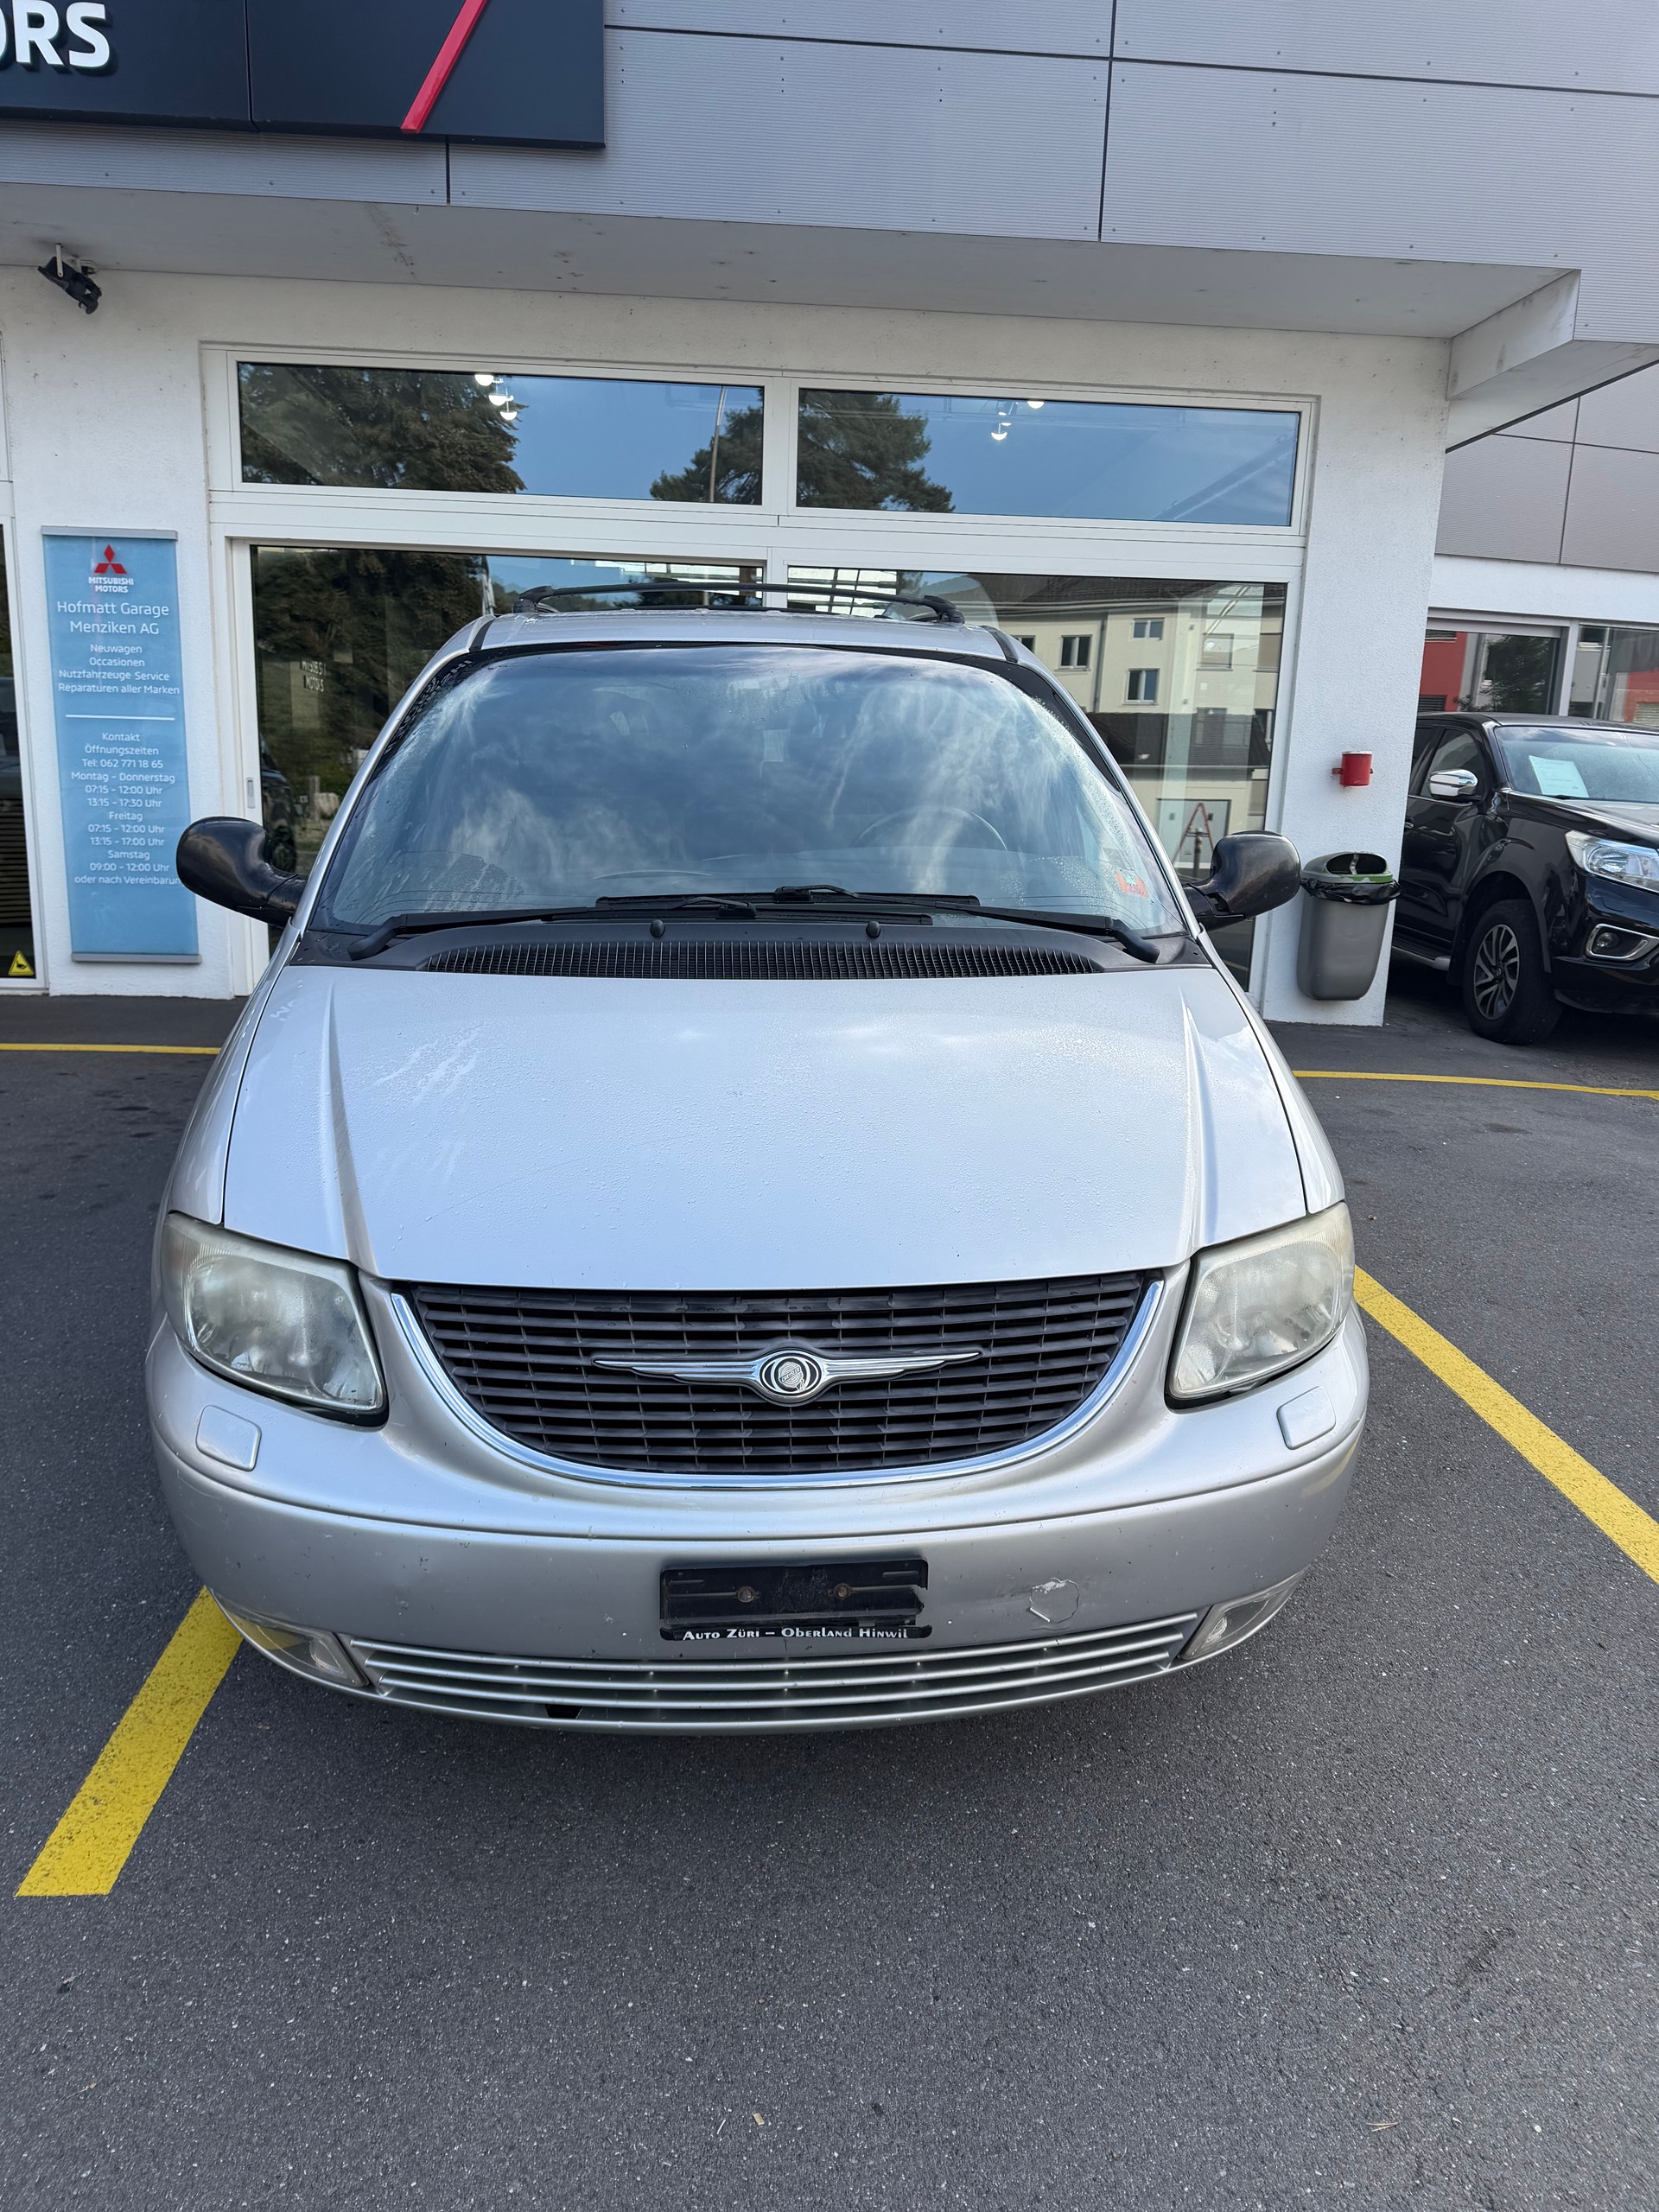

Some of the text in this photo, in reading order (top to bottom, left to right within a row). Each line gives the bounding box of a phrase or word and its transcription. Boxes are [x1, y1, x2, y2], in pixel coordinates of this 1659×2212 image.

[88, 576, 134, 586] MITSUBISHI
[95, 585, 129, 594] MOTORS
[57, 601, 169, 618] Hofmatt Garage
[70, 620, 159, 634] Menziken AG
[90, 644, 143, 655] Neuwagen
[89, 657, 145, 667] Occasionen
[59, 670, 169, 681] Nutzfahrzeuge Service
[58, 683, 180, 695] Reparaturen aller Marken
[102, 733, 140, 742] Kontakt
[85, 744, 159, 757] Öffnungszeiten
[100, 759, 119, 768] 062
[121, 759, 137, 768] 771
[137, 760, 149, 768] 18
[151, 760, 163, 769] 65
[71, 772, 109, 783] Montag
[119, 772, 175, 784] Donnerstag
[119, 785, 143, 795] 12:00
[146, 785, 162, 795] Uhr
[119, 798, 143, 808] 17:30
[145, 798, 162, 808] Uhr
[109, 811, 143, 822] Freitag
[121, 823, 146, 834] 12:00
[148, 824, 165, 834] Uhr
[122, 837, 146, 847] 17:00
[148, 837, 165, 847] Uhr
[107, 849, 150, 861] Samstag
[126, 862, 150, 873] 12:00
[153, 863, 170, 873] Uhr
[74, 875, 181, 887] oder nach Vereinbarun
